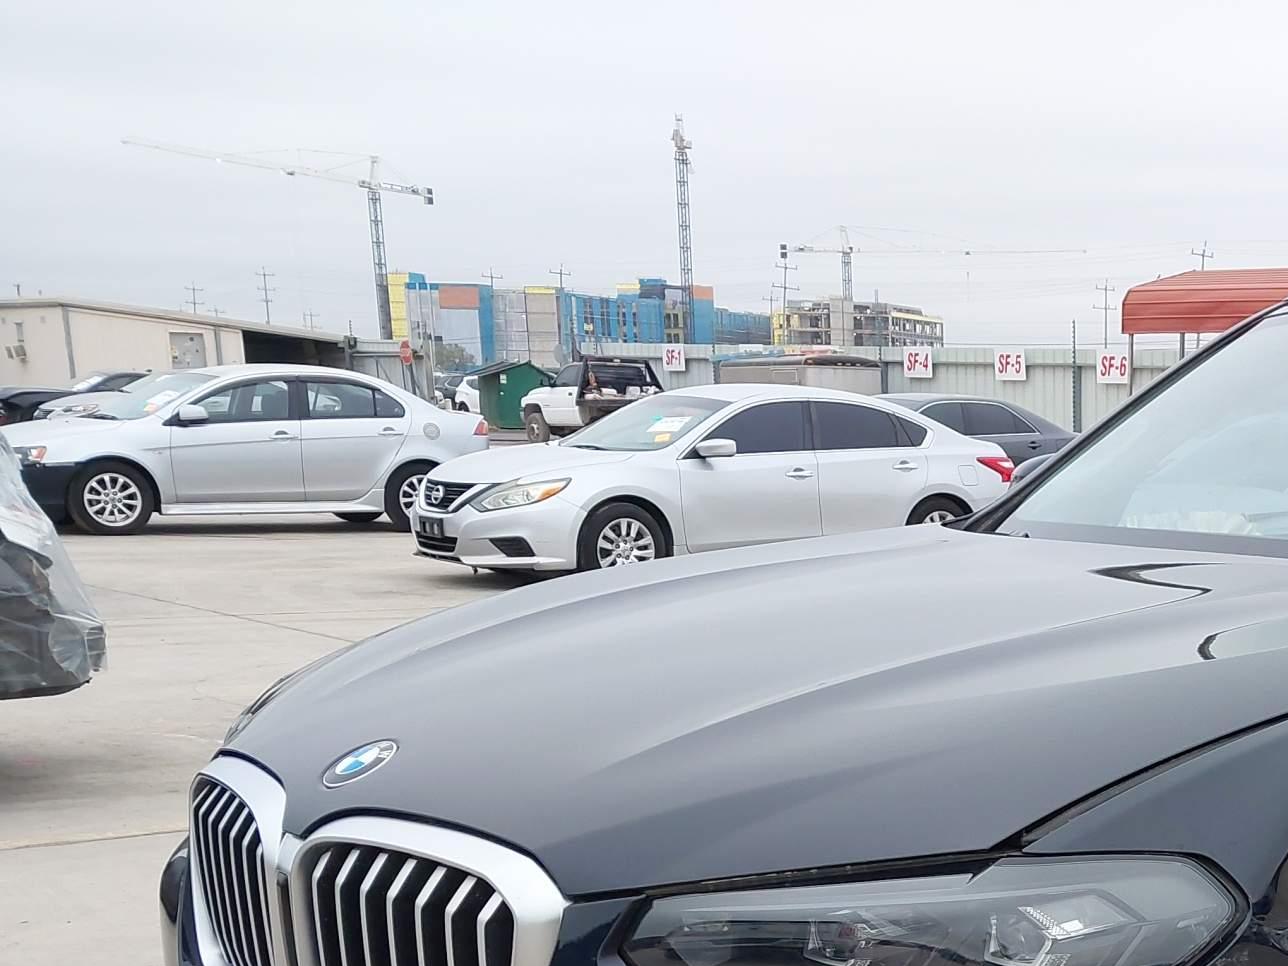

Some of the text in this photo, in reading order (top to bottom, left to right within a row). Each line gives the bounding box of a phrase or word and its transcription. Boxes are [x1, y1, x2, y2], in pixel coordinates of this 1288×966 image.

[666, 349, 681, 366] SF-1
[907, 352, 929, 372] SF-4
[998, 353, 1022, 374] SF-5
[1101, 355, 1127, 377] SF-6
